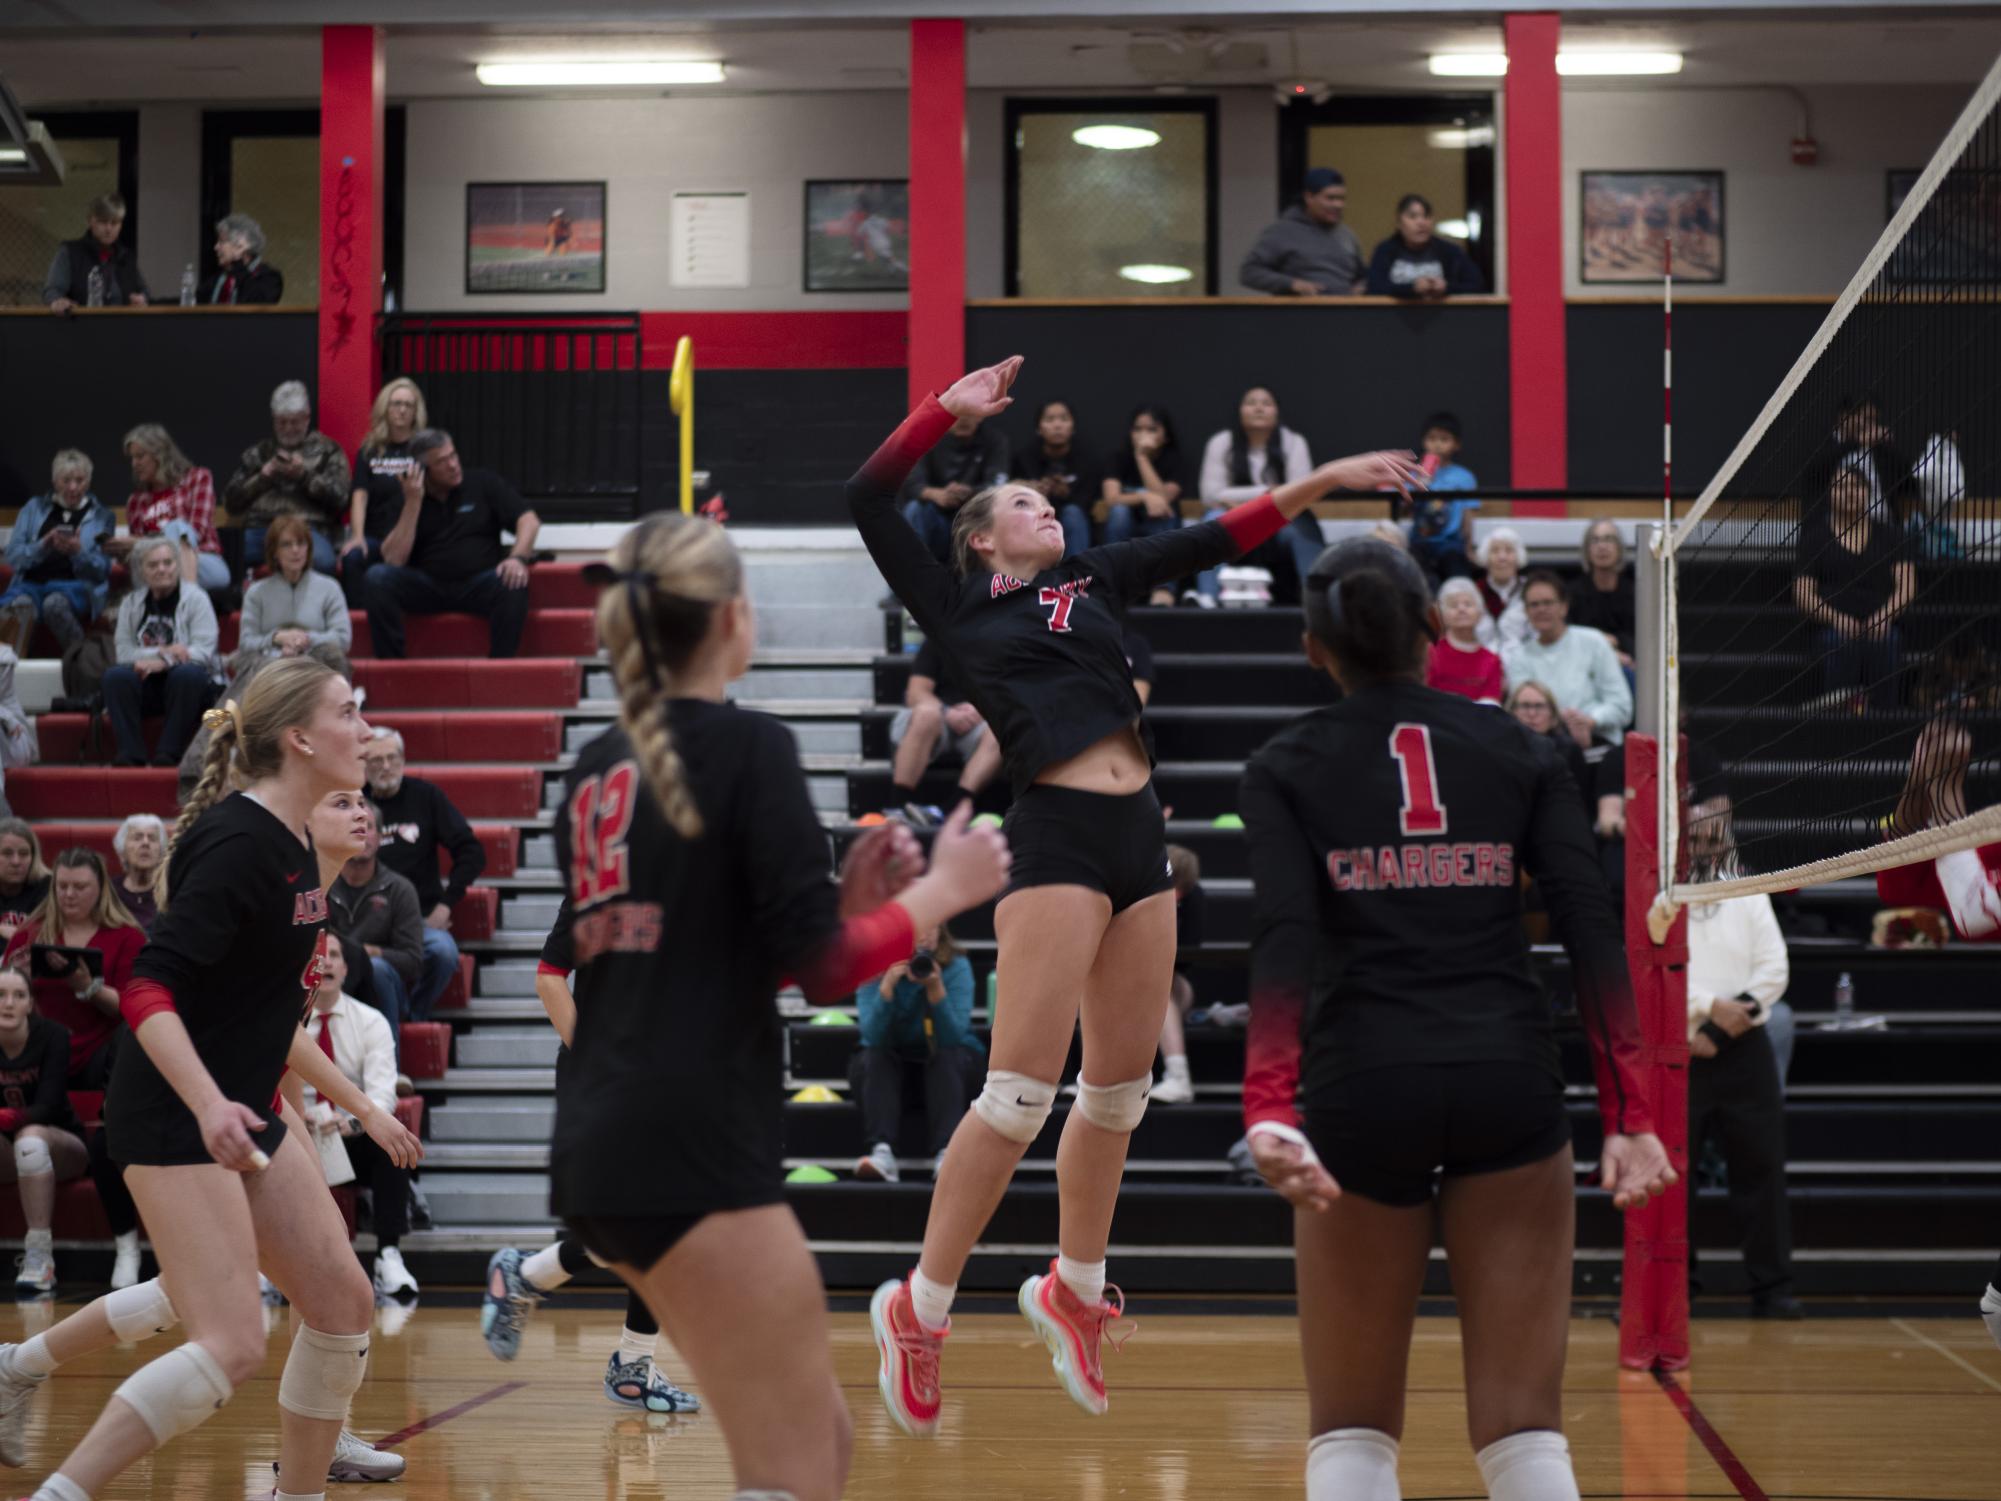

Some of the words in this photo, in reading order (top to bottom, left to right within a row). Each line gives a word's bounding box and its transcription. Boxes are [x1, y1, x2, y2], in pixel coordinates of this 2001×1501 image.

[1038, 586, 1074, 633] 7
[1388, 721, 1448, 836] 1
[569, 757, 639, 911] 12
[1325, 841, 1516, 892] CHARGERS
